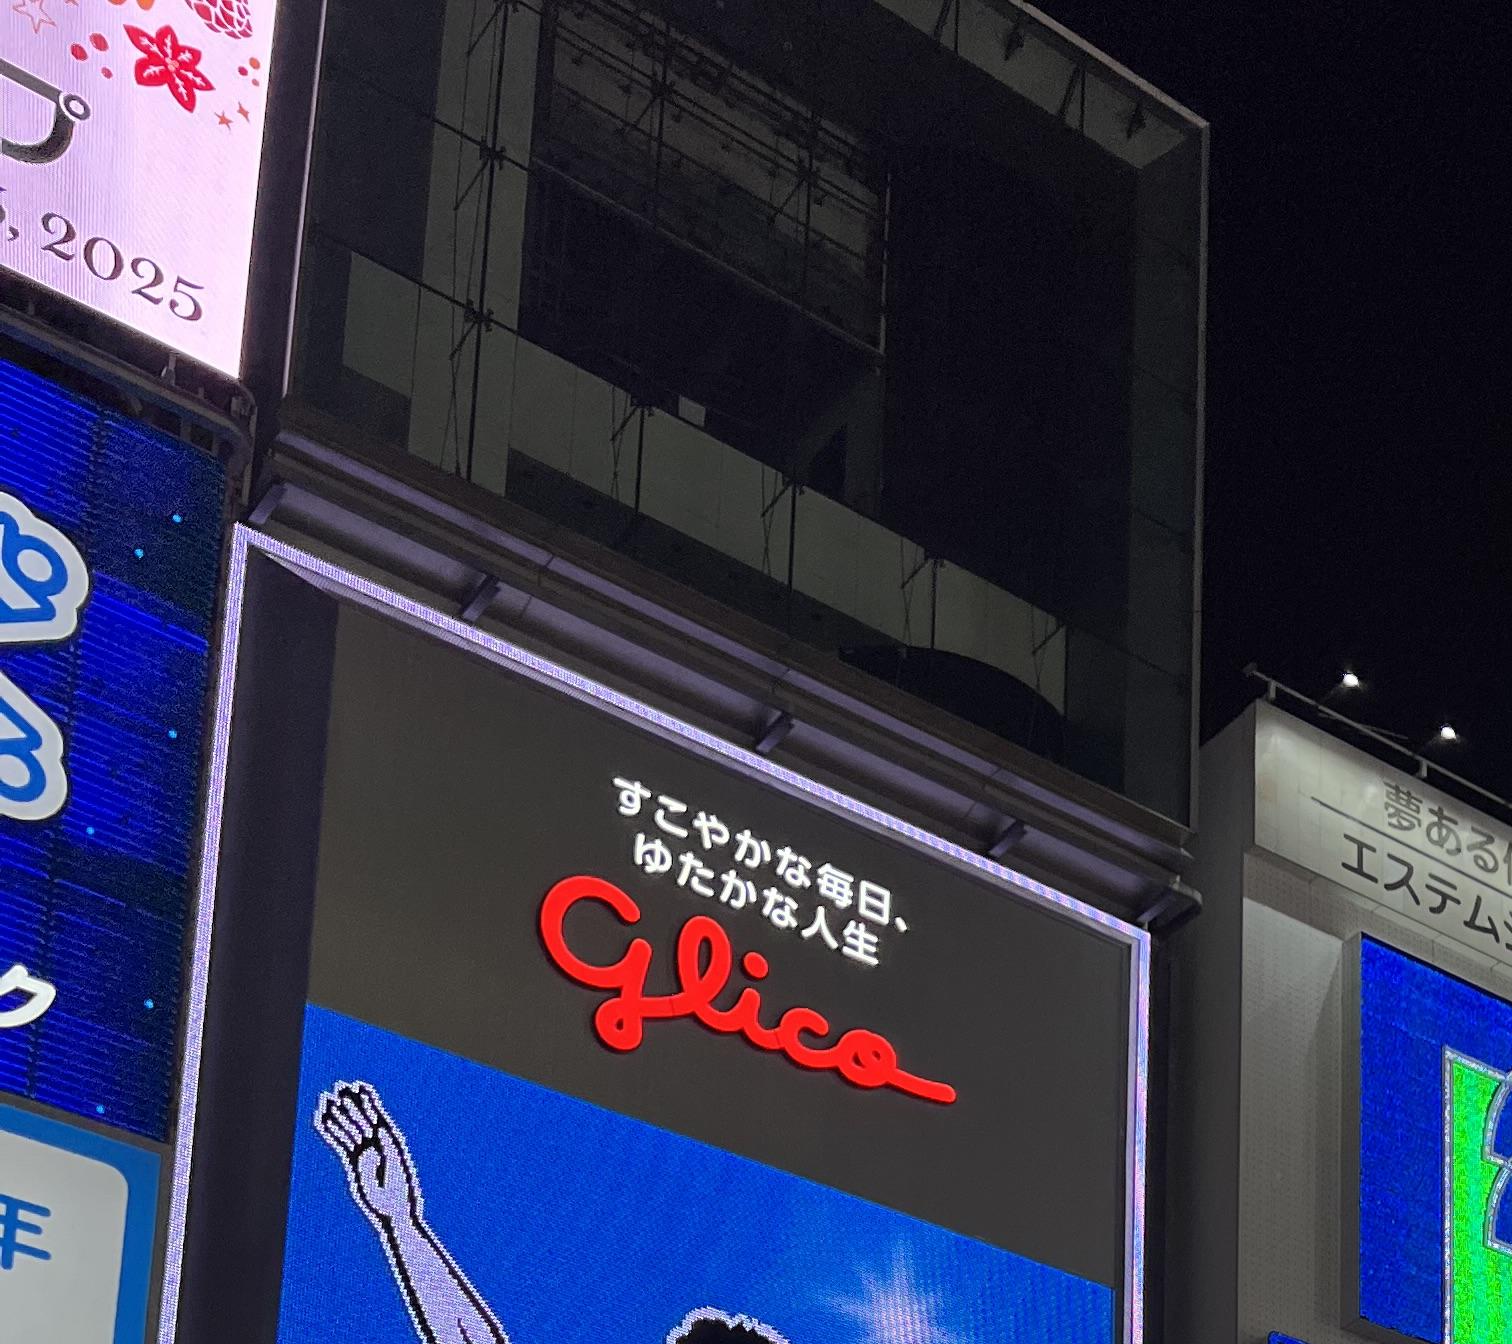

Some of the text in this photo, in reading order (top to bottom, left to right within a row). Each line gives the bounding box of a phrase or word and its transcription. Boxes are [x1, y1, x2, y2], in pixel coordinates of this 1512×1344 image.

[41, 212, 206, 322] 2025
[612, 776, 908, 933] すこやかな毎日、
[633, 832, 880, 967] ゆたかな人生
[539, 875, 957, 1103] Glico
